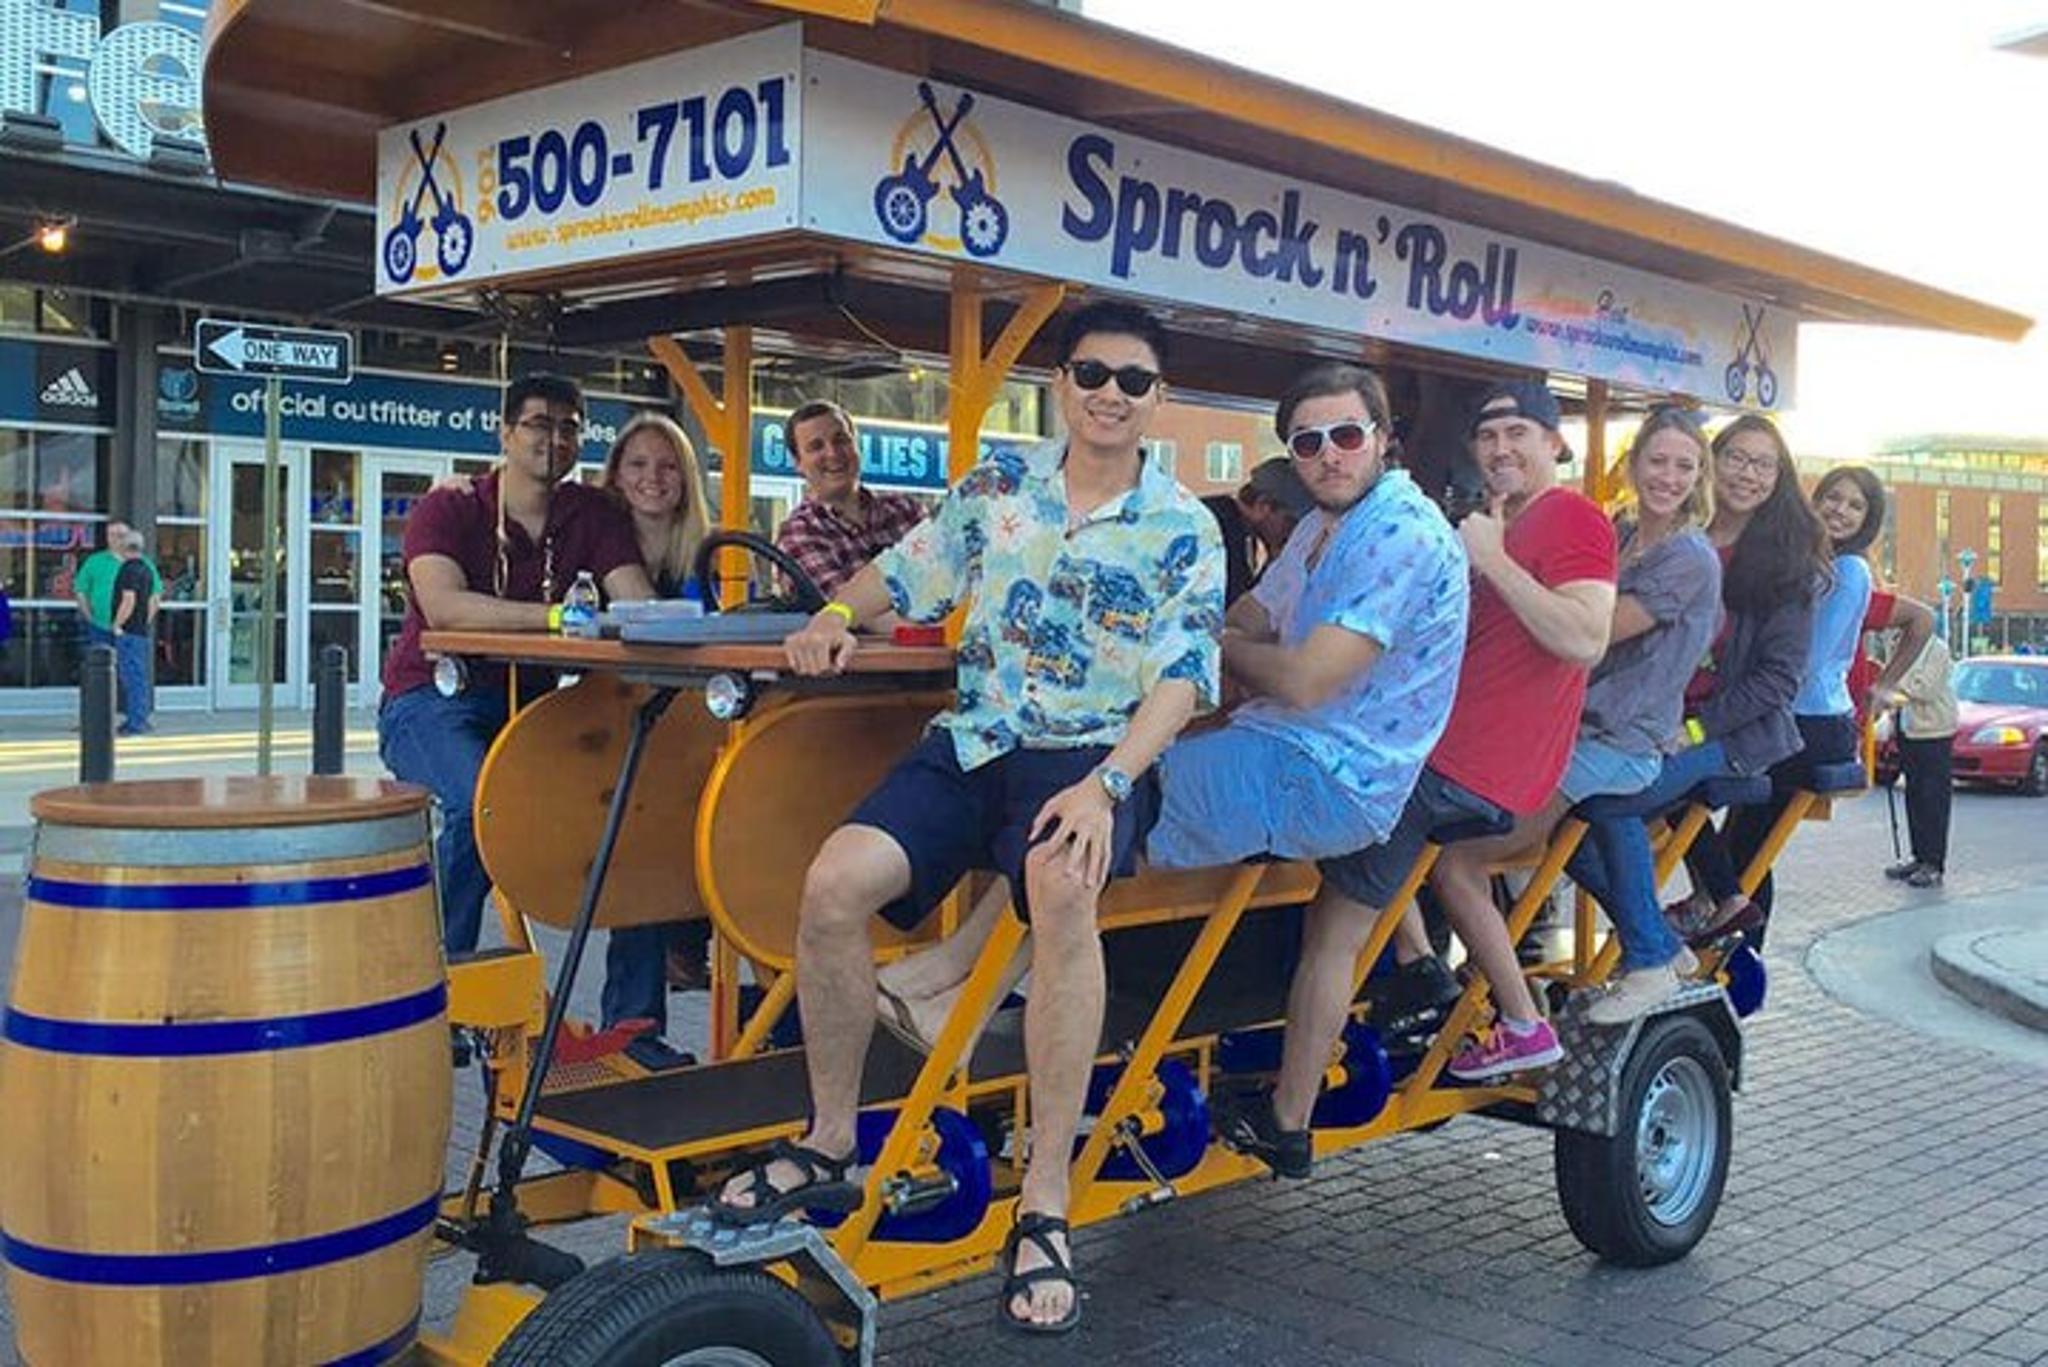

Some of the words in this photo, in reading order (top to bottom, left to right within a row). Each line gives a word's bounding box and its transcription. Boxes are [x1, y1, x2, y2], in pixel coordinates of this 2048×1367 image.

[498, 77, 791, 220] 500-7101
[1062, 134, 1324, 278] Sprock
[1395, 223, 1520, 332] Roll
[244, 340, 287, 364] ONE
[292, 344, 335, 367] WAY
[40, 390, 98, 407] adidas
[333, 400, 441, 428] outfitter
[448, 410, 474, 431] of
